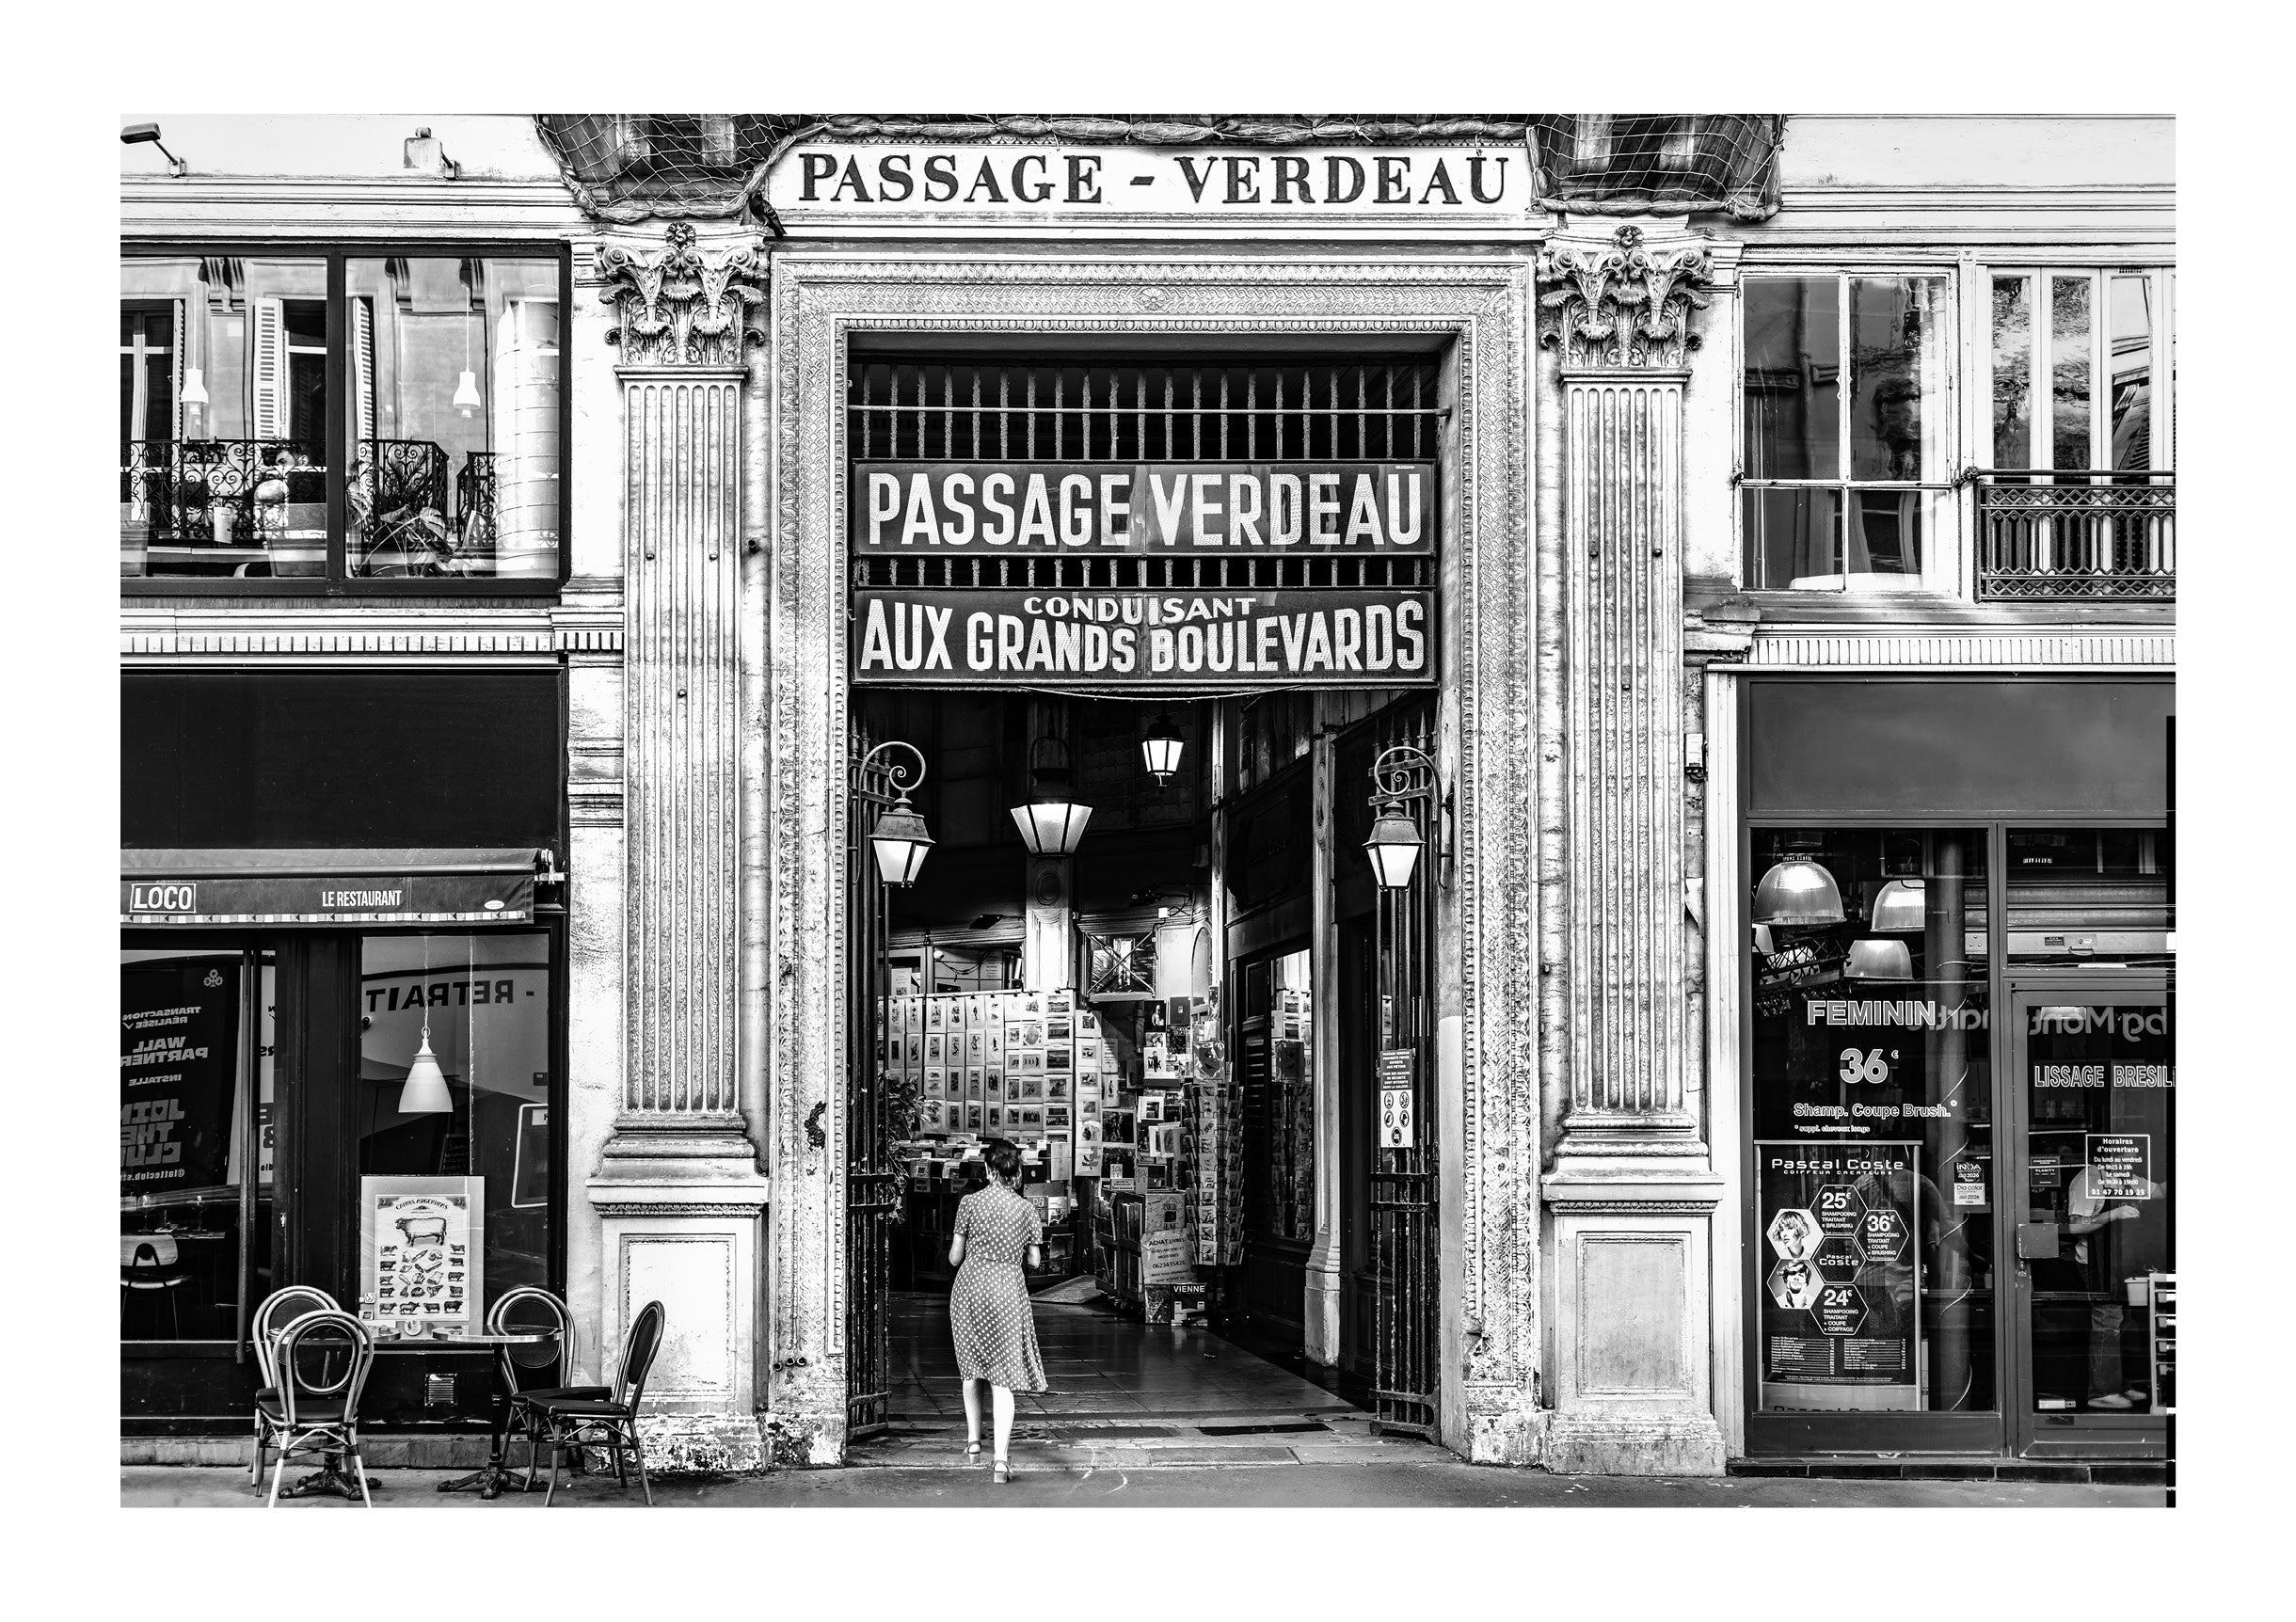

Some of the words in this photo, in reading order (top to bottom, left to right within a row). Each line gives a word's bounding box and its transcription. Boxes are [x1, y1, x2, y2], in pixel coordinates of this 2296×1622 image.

[798, 153, 1104, 203] PASSAGE
[1174, 154, 1510, 206] VERDEAU
[868, 472, 1131, 548] PASSAGE
[1149, 472, 1422, 548] VERDEAU
[1023, 596, 1257, 626] CONDUISANT
[860, 599, 952, 672] AUX
[966, 612, 1138, 674] GRANDS
[1151, 599, 1426, 674] BOULEVARDS
[134, 886, 192, 910] LOCO
[322, 891, 335, 907] LE
[337, 890, 403, 907] RESTAURANT
[1808, 1000, 1936, 1026] FEMININ
[2034, 1065, 2105, 1088] LISSAGE
[1794, 1103, 1849, 1120] Shamp.
[1852, 1104, 1900, 1120] Coupe
[1772, 1158, 1840, 1169] Pascal
[1847, 1158, 1904, 1169] Coste
[1819, 1258, 1859, 1266] Coste
